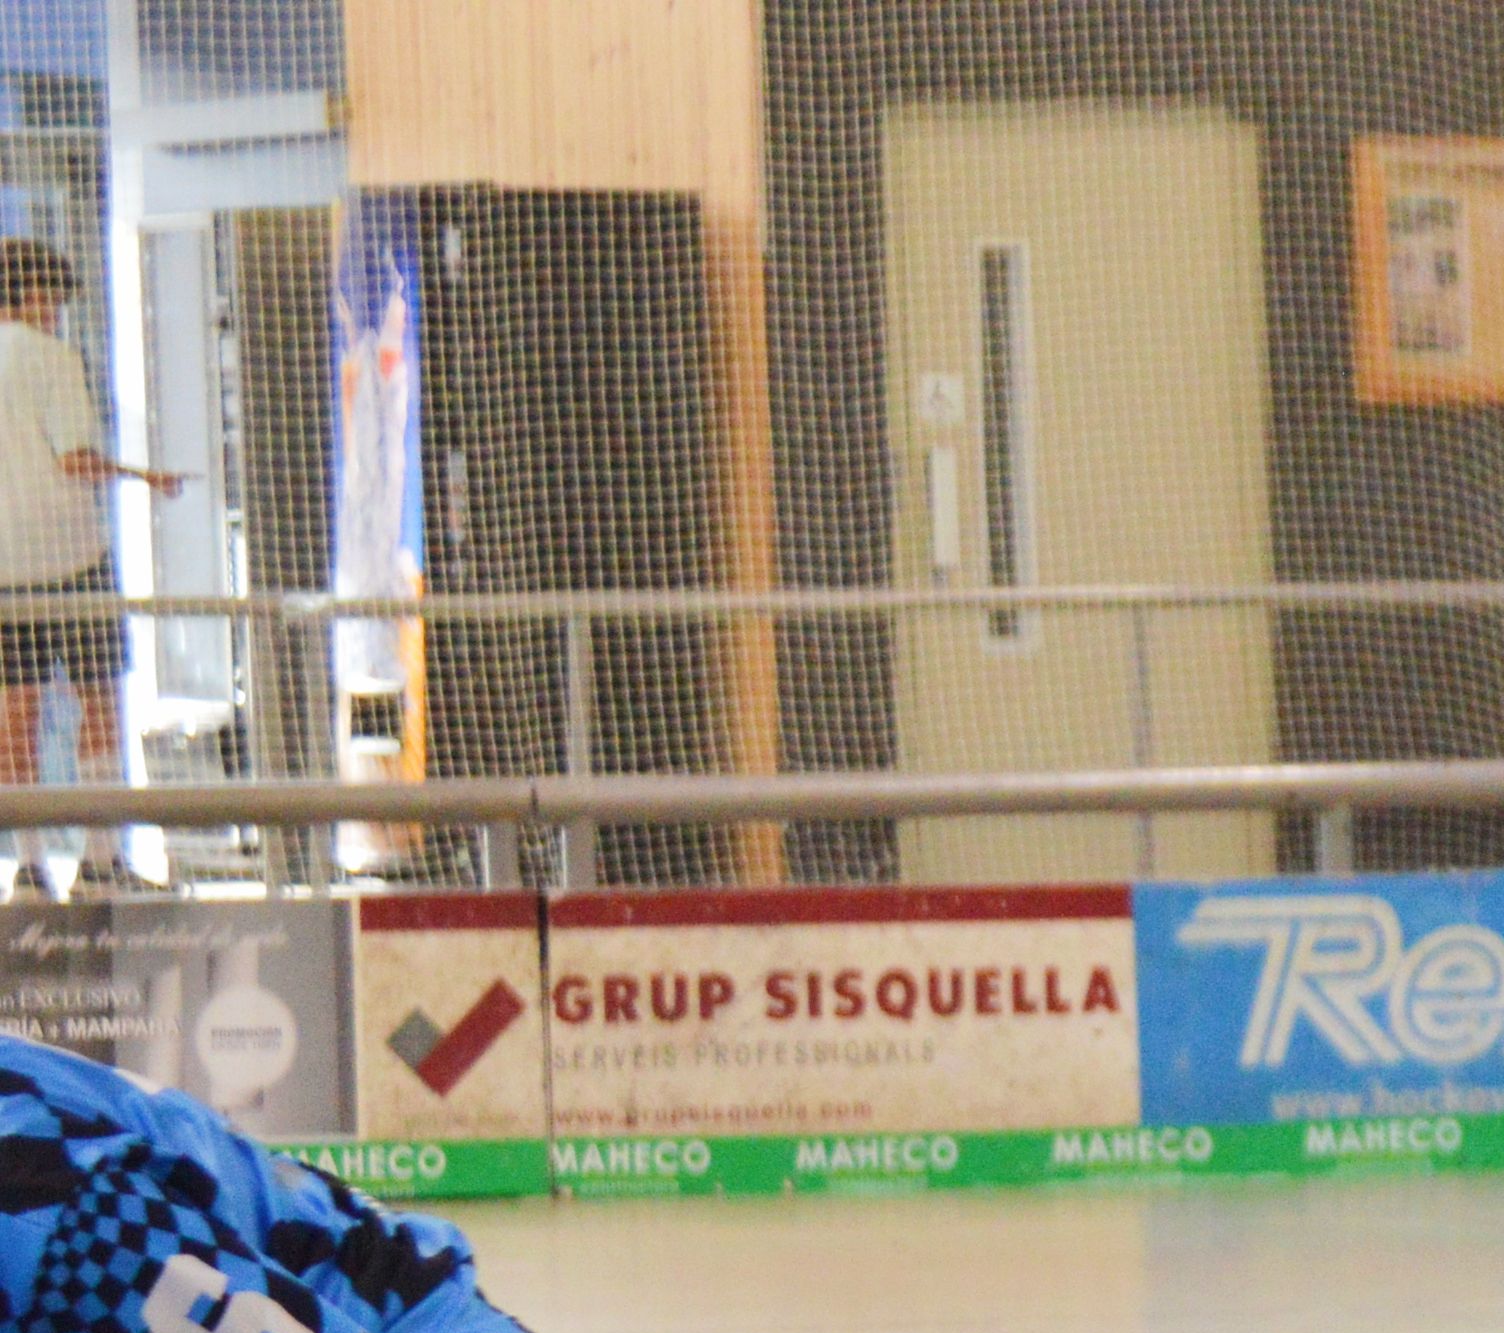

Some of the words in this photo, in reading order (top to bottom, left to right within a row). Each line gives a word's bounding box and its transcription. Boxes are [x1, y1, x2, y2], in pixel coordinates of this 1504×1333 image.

[553, 972, 736, 1024] GRUP
[763, 964, 1122, 1021] SISQUELLA
[553, 1139, 712, 1175] MAHECO
[795, 1135, 960, 1171] MAHECO
[1052, 1125, 1214, 1164] MAHECO
[1304, 1116, 1464, 1154] MAHECO
